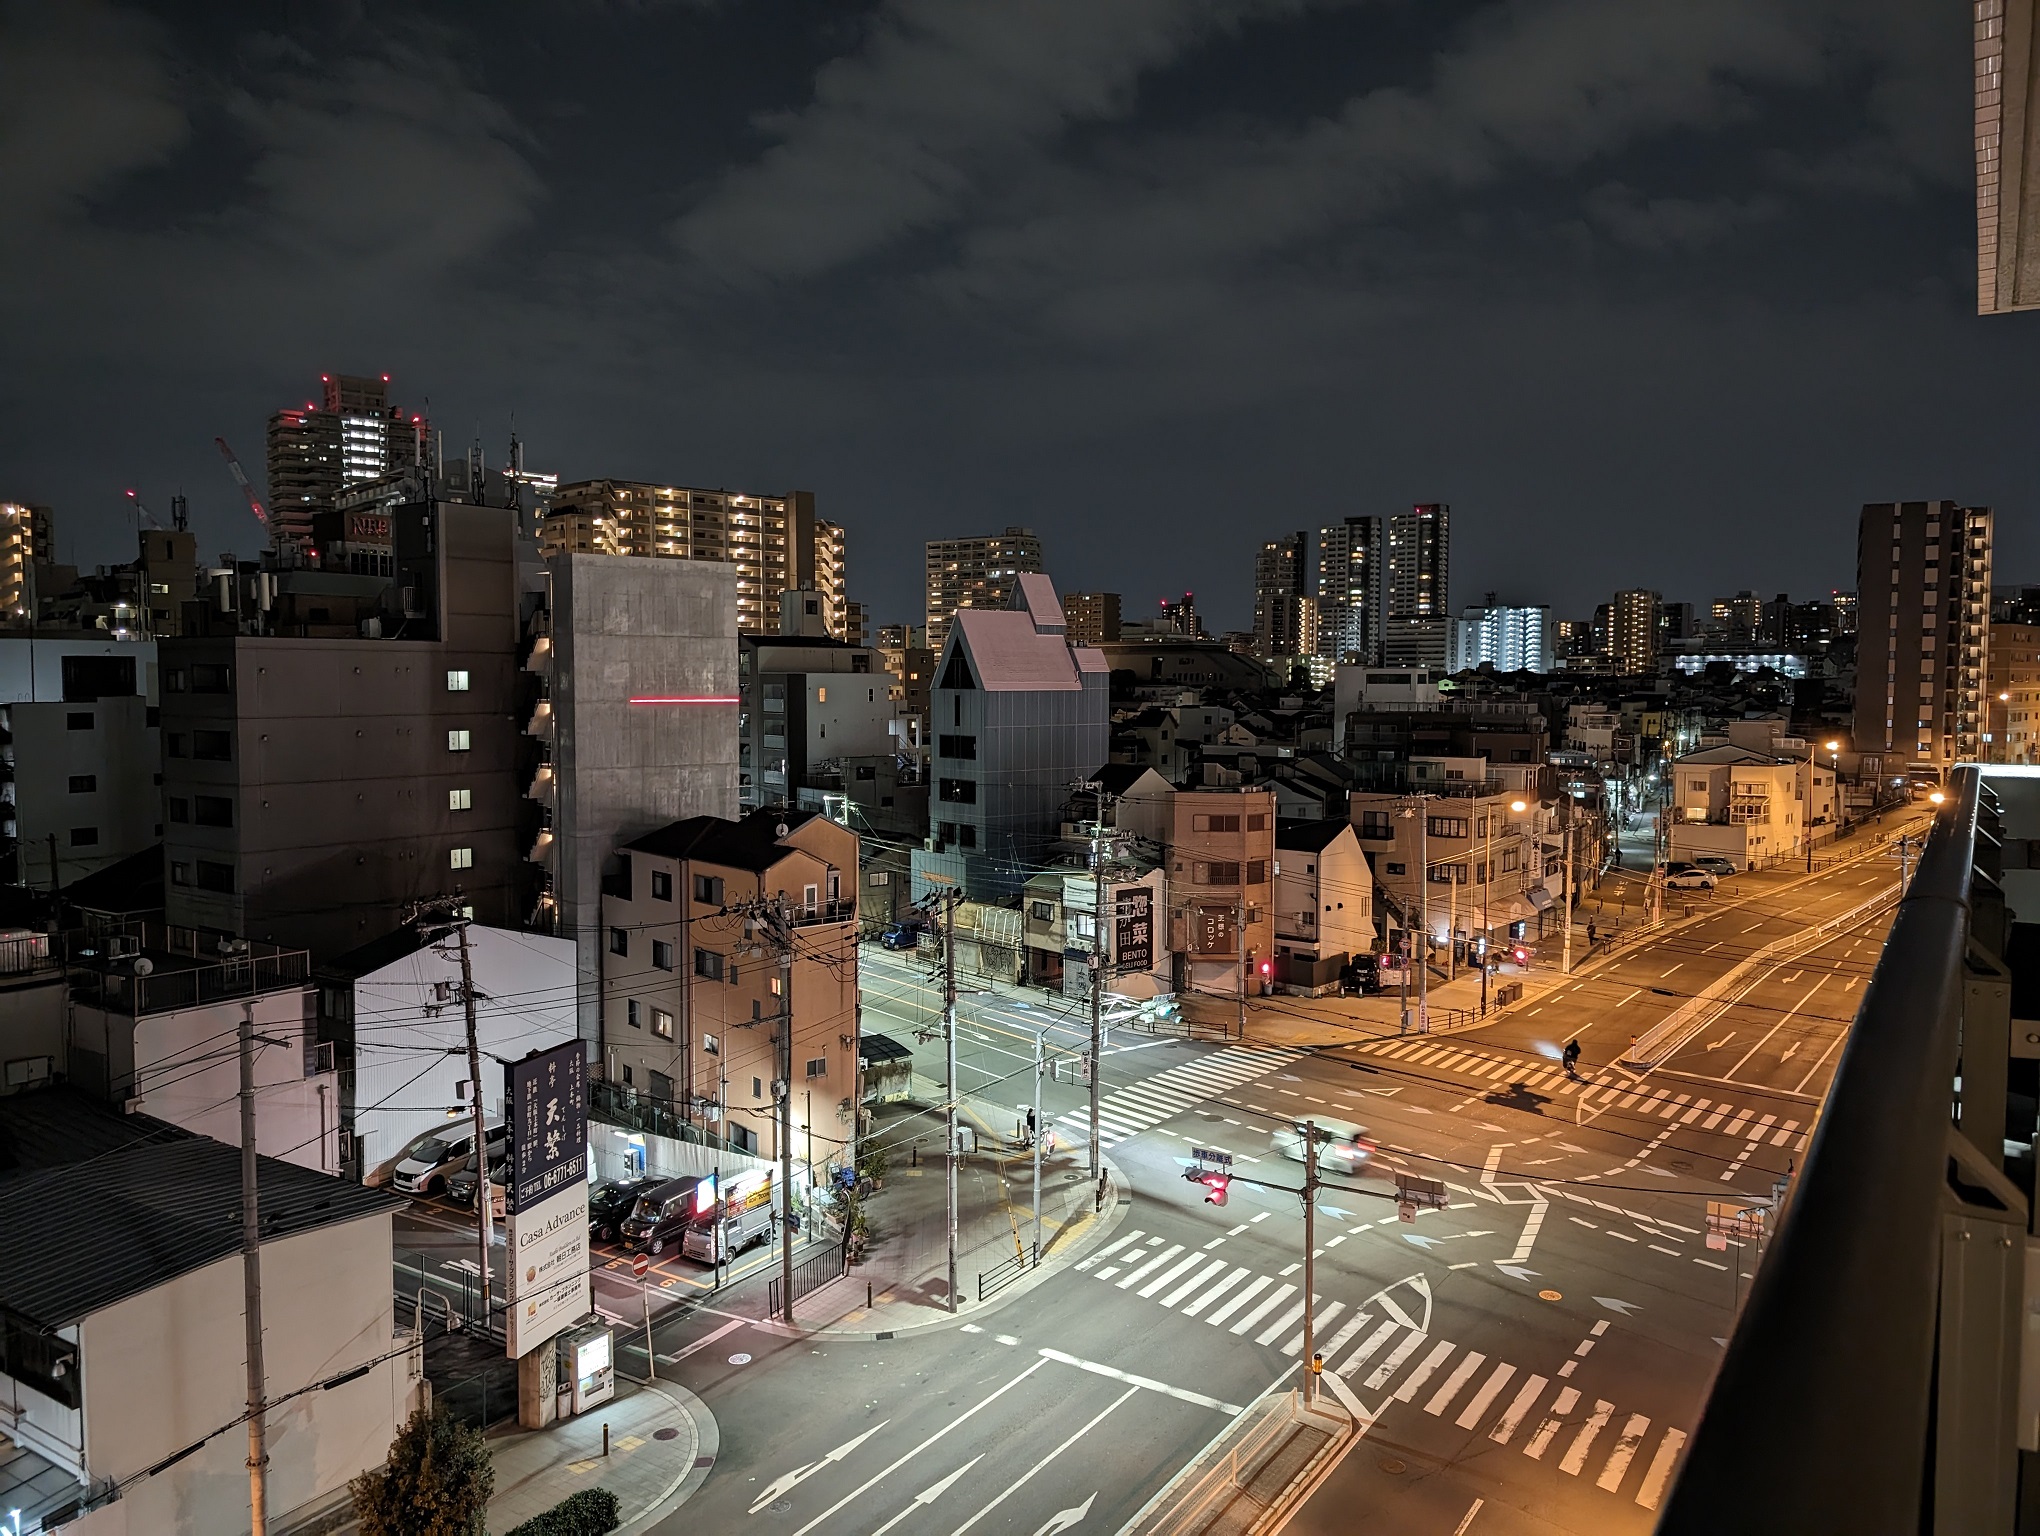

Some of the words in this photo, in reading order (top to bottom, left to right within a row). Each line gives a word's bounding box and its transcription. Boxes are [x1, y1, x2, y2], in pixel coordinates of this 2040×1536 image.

[1132, 895, 1148, 945] 惣菜
[1207, 918, 1215, 949] コロッケ
[1122, 948, 1148, 961] BENTO
[505, 1086, 514, 1105] 大阪
[505, 1115, 514, 1143] 上本町
[544, 1097, 561, 1161] 天繁
[505, 1153, 515, 1176] 料亭
[1192, 1147, 1232, 1166] 歩車分離式
[543, 1157, 583, 1189] 06-6771-6511
[520, 1226, 544, 1248] Casa
[545, 1203, 586, 1235] Advance
